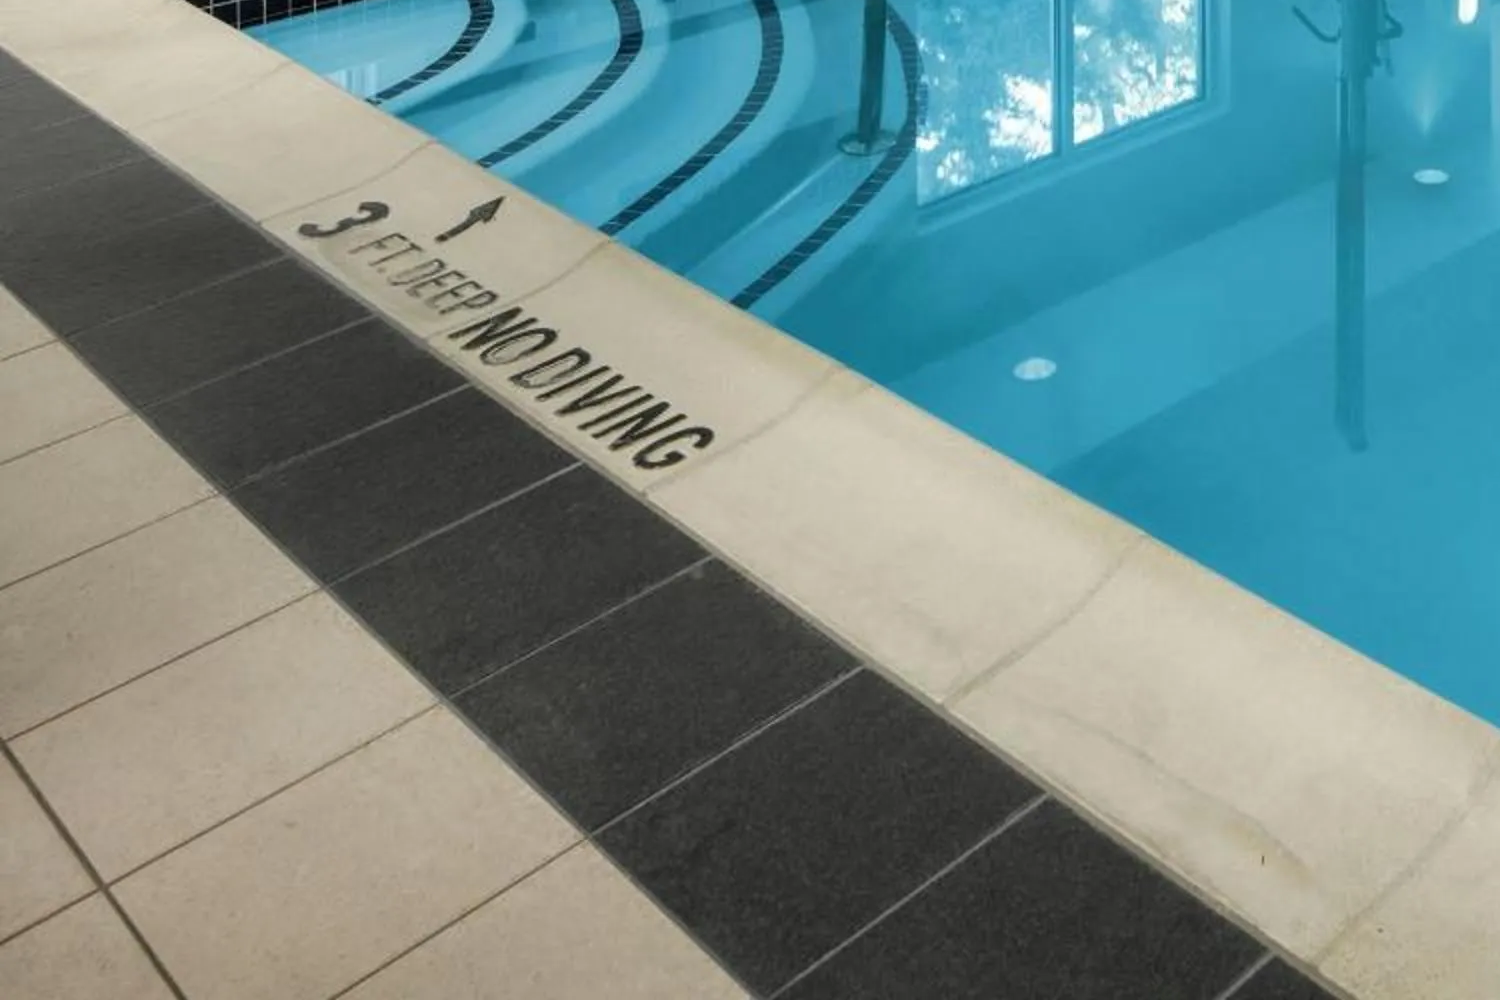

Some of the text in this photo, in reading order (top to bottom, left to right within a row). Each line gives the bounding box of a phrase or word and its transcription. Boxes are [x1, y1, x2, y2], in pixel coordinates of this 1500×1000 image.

[299, 201, 390, 238] 3
[388, 258, 499, 315] DEEP
[448, 306, 560, 367] NO
[510, 347, 715, 470] DIVING
